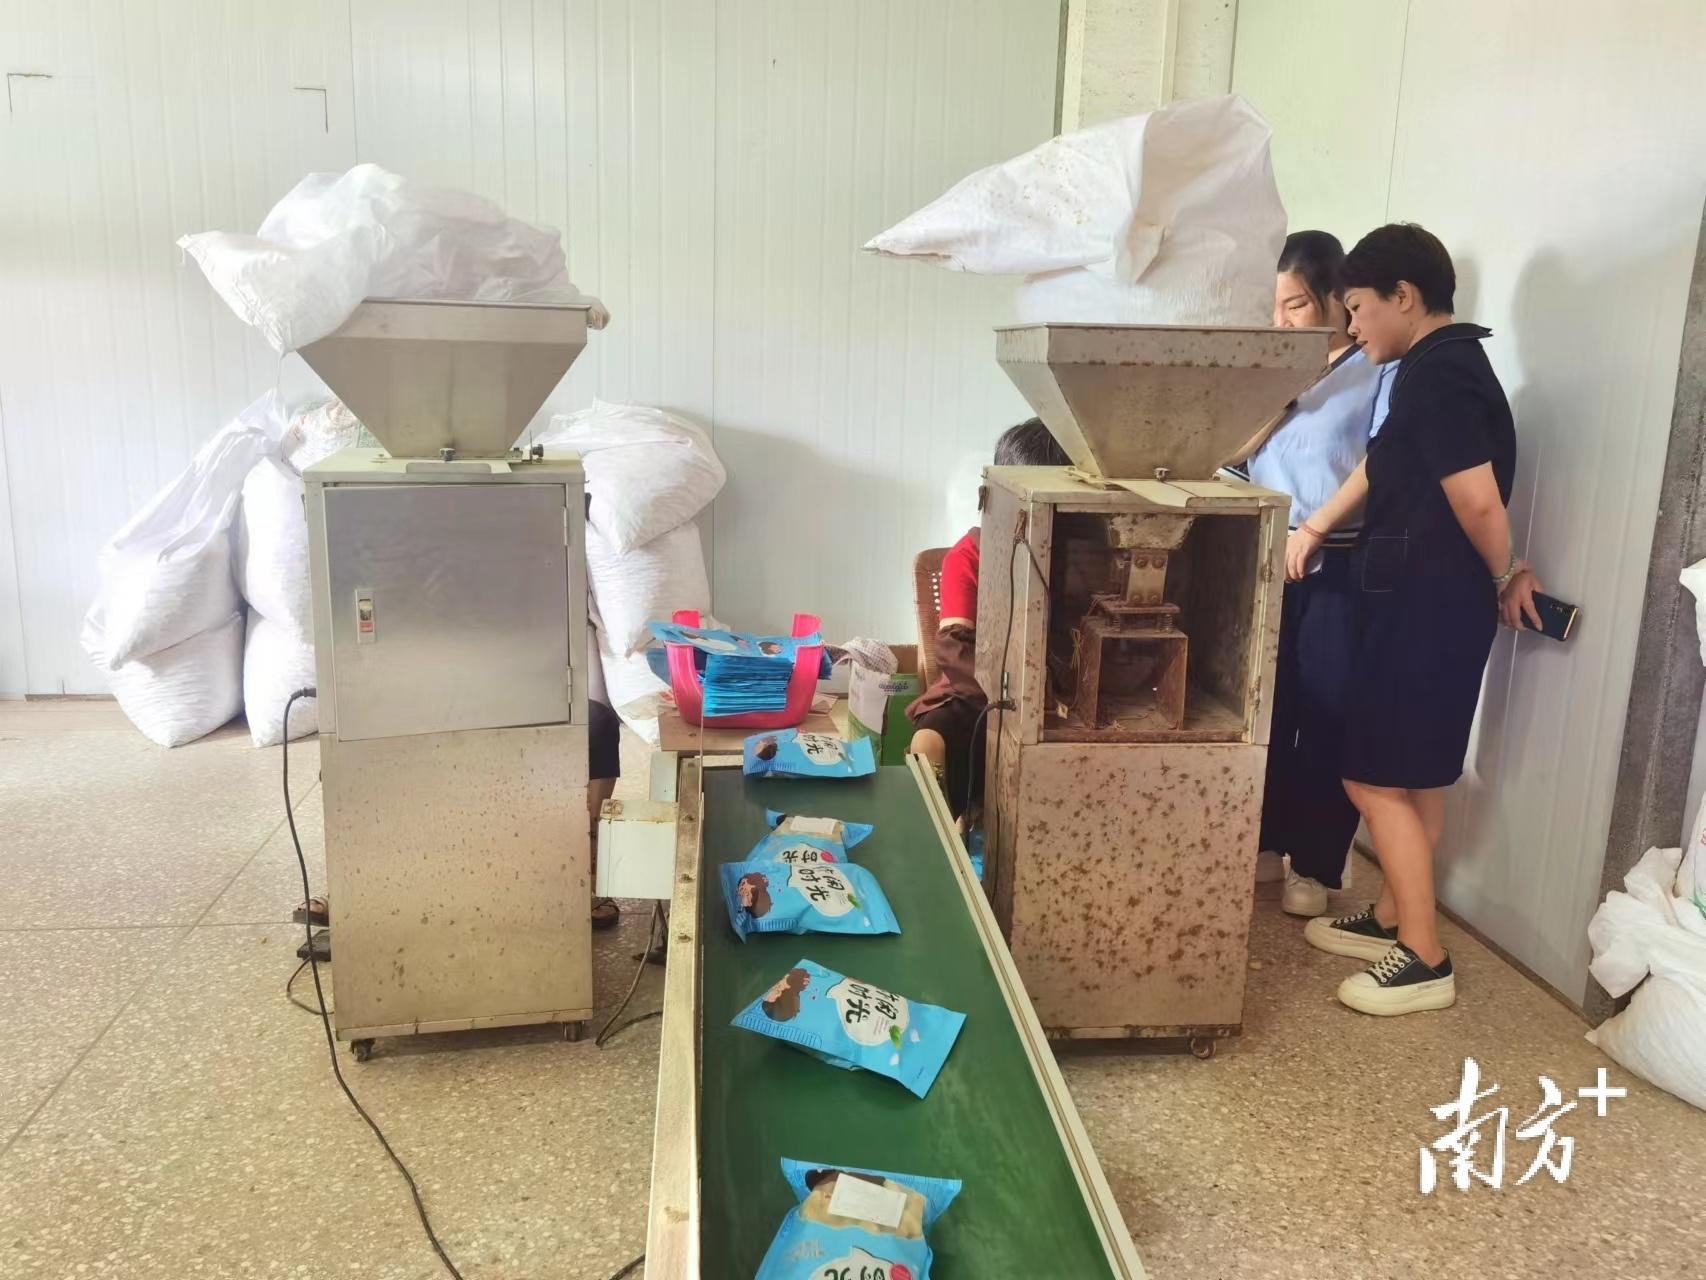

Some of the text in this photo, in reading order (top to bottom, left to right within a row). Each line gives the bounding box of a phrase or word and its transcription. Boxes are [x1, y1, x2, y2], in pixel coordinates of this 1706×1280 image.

[782, 849, 818, 864] 时光
[798, 868, 830, 902] 时光
[845, 983, 873, 1024] 时光
